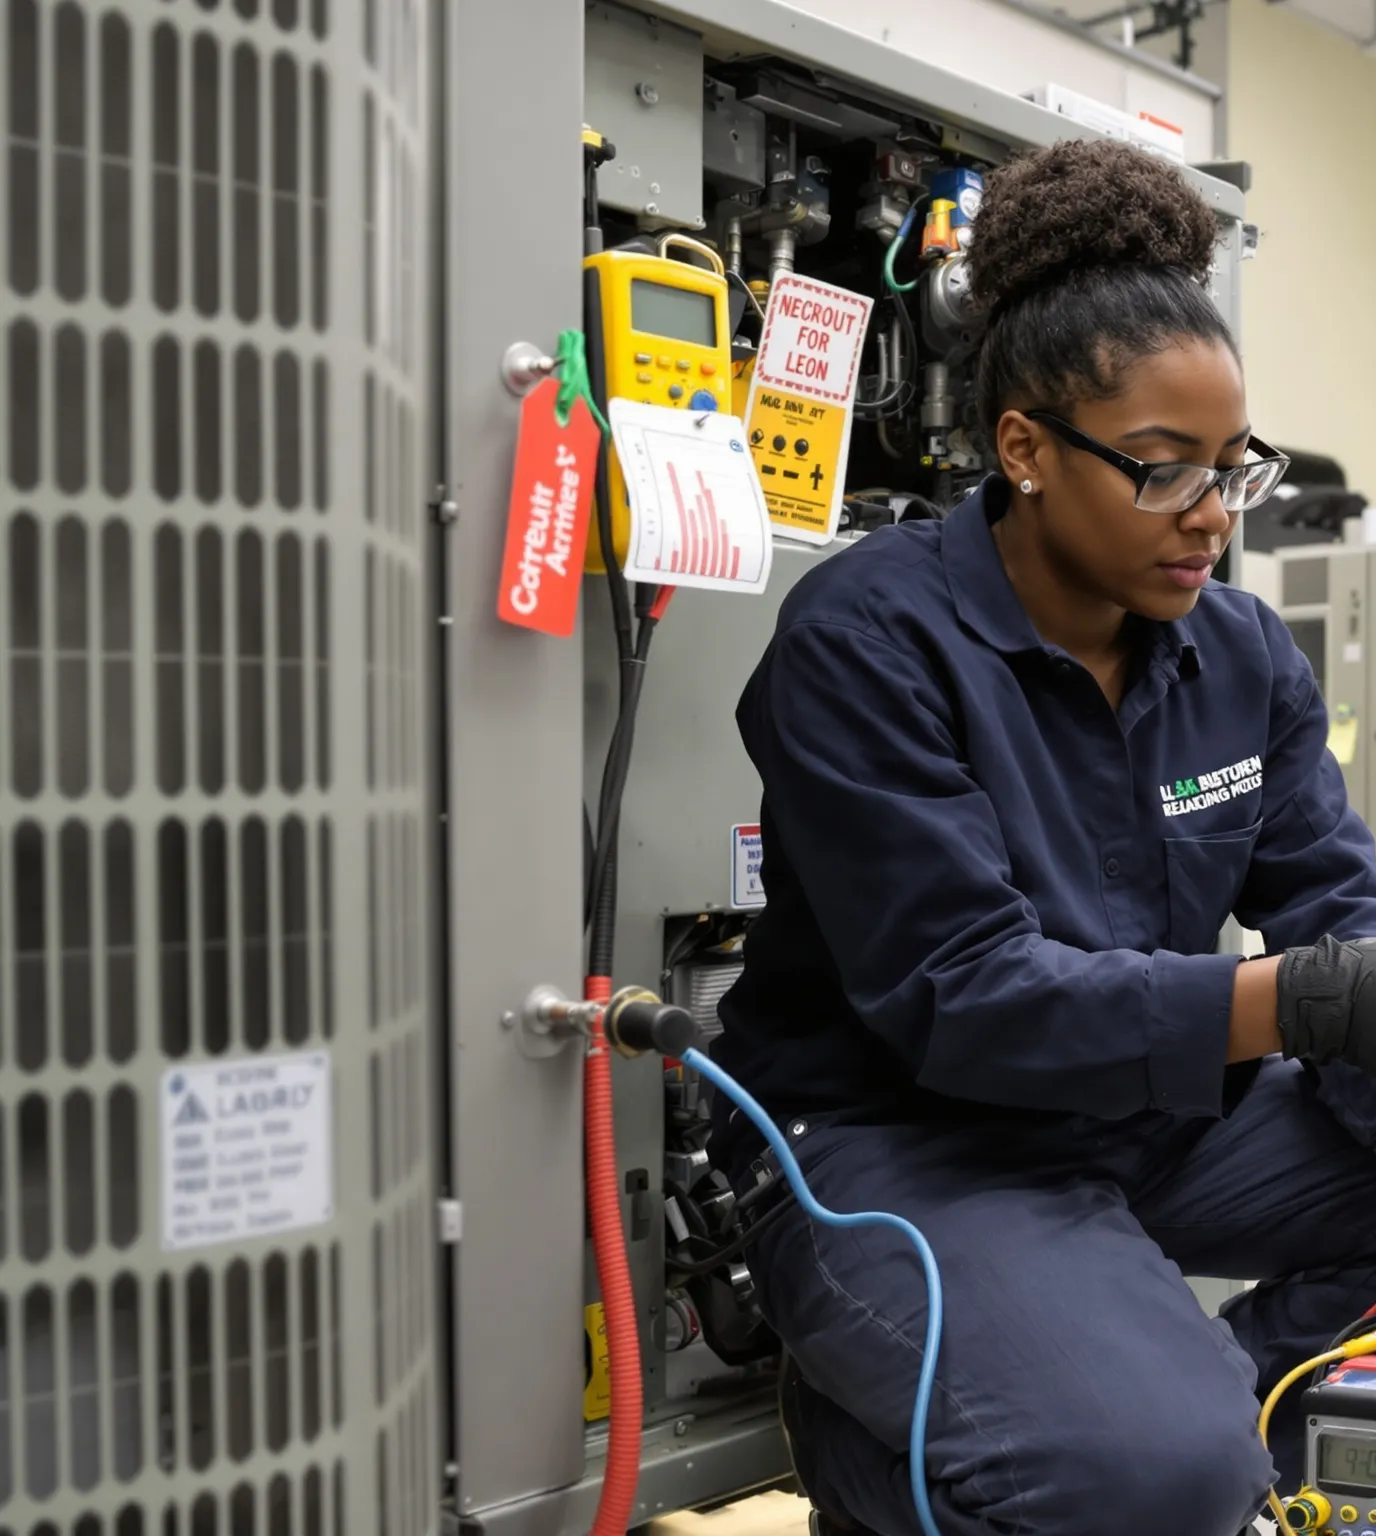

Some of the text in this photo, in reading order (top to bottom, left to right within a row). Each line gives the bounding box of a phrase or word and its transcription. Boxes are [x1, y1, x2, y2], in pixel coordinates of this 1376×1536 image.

[778, 294, 856, 335] NECROUT
[797, 326, 830, 353] FOR
[785, 352, 828, 382] LEON
